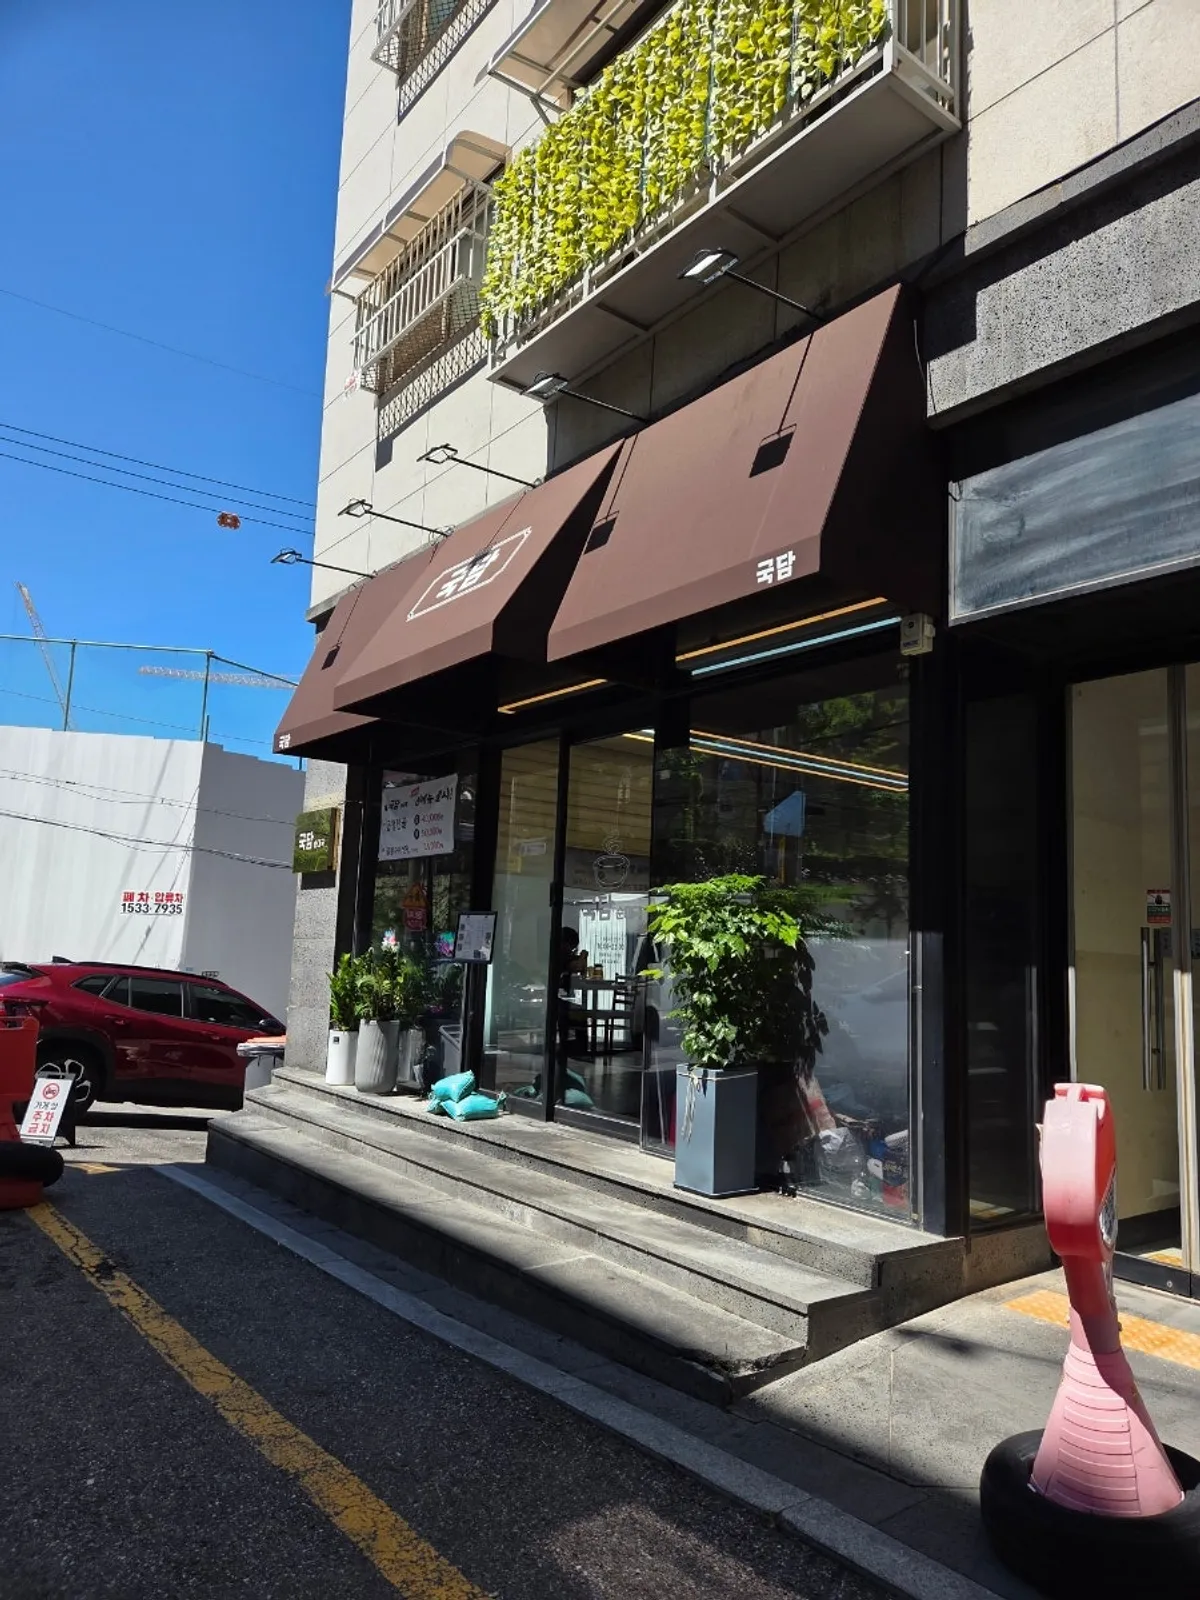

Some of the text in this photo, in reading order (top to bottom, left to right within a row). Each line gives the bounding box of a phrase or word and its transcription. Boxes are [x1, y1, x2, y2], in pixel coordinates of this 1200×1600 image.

[436, 547, 500, 599] 국담
[756, 550, 796, 584] 국담
[278, 733, 291, 750] 국담
[298, 831, 315, 851] 국담
[32, 1110, 55, 1122] 주차
[27, 1122, 51, 1134] 금지
